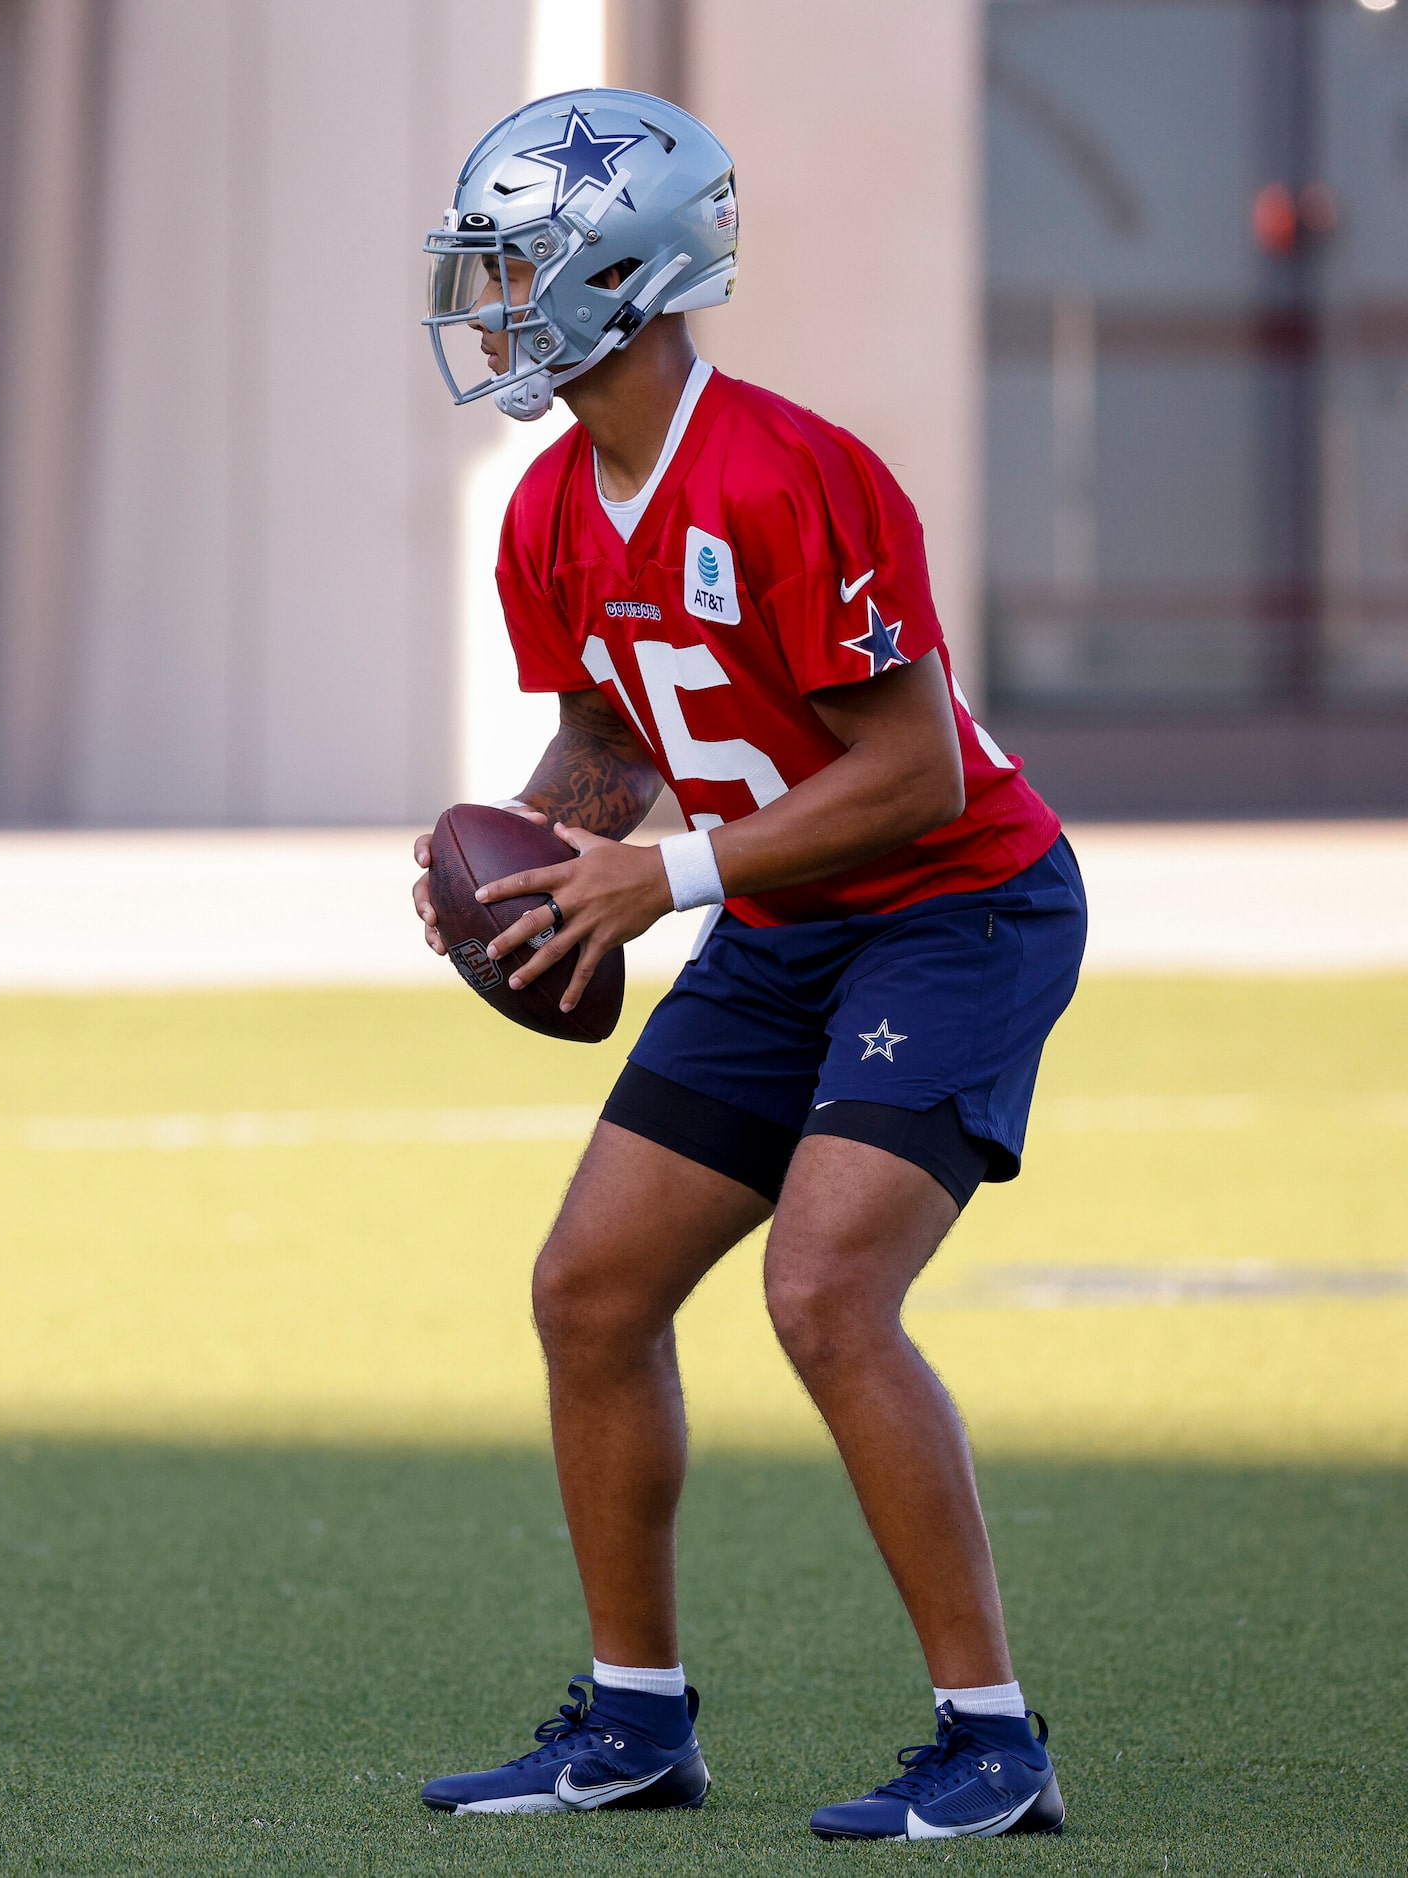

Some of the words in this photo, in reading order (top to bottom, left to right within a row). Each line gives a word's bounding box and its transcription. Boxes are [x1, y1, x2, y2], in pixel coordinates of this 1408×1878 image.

[605, 602, 661, 621] COWBOYS
[694, 589, 725, 613] AT&T
[580, 634, 790, 832] 15
[463, 943, 498, 985] NFL
